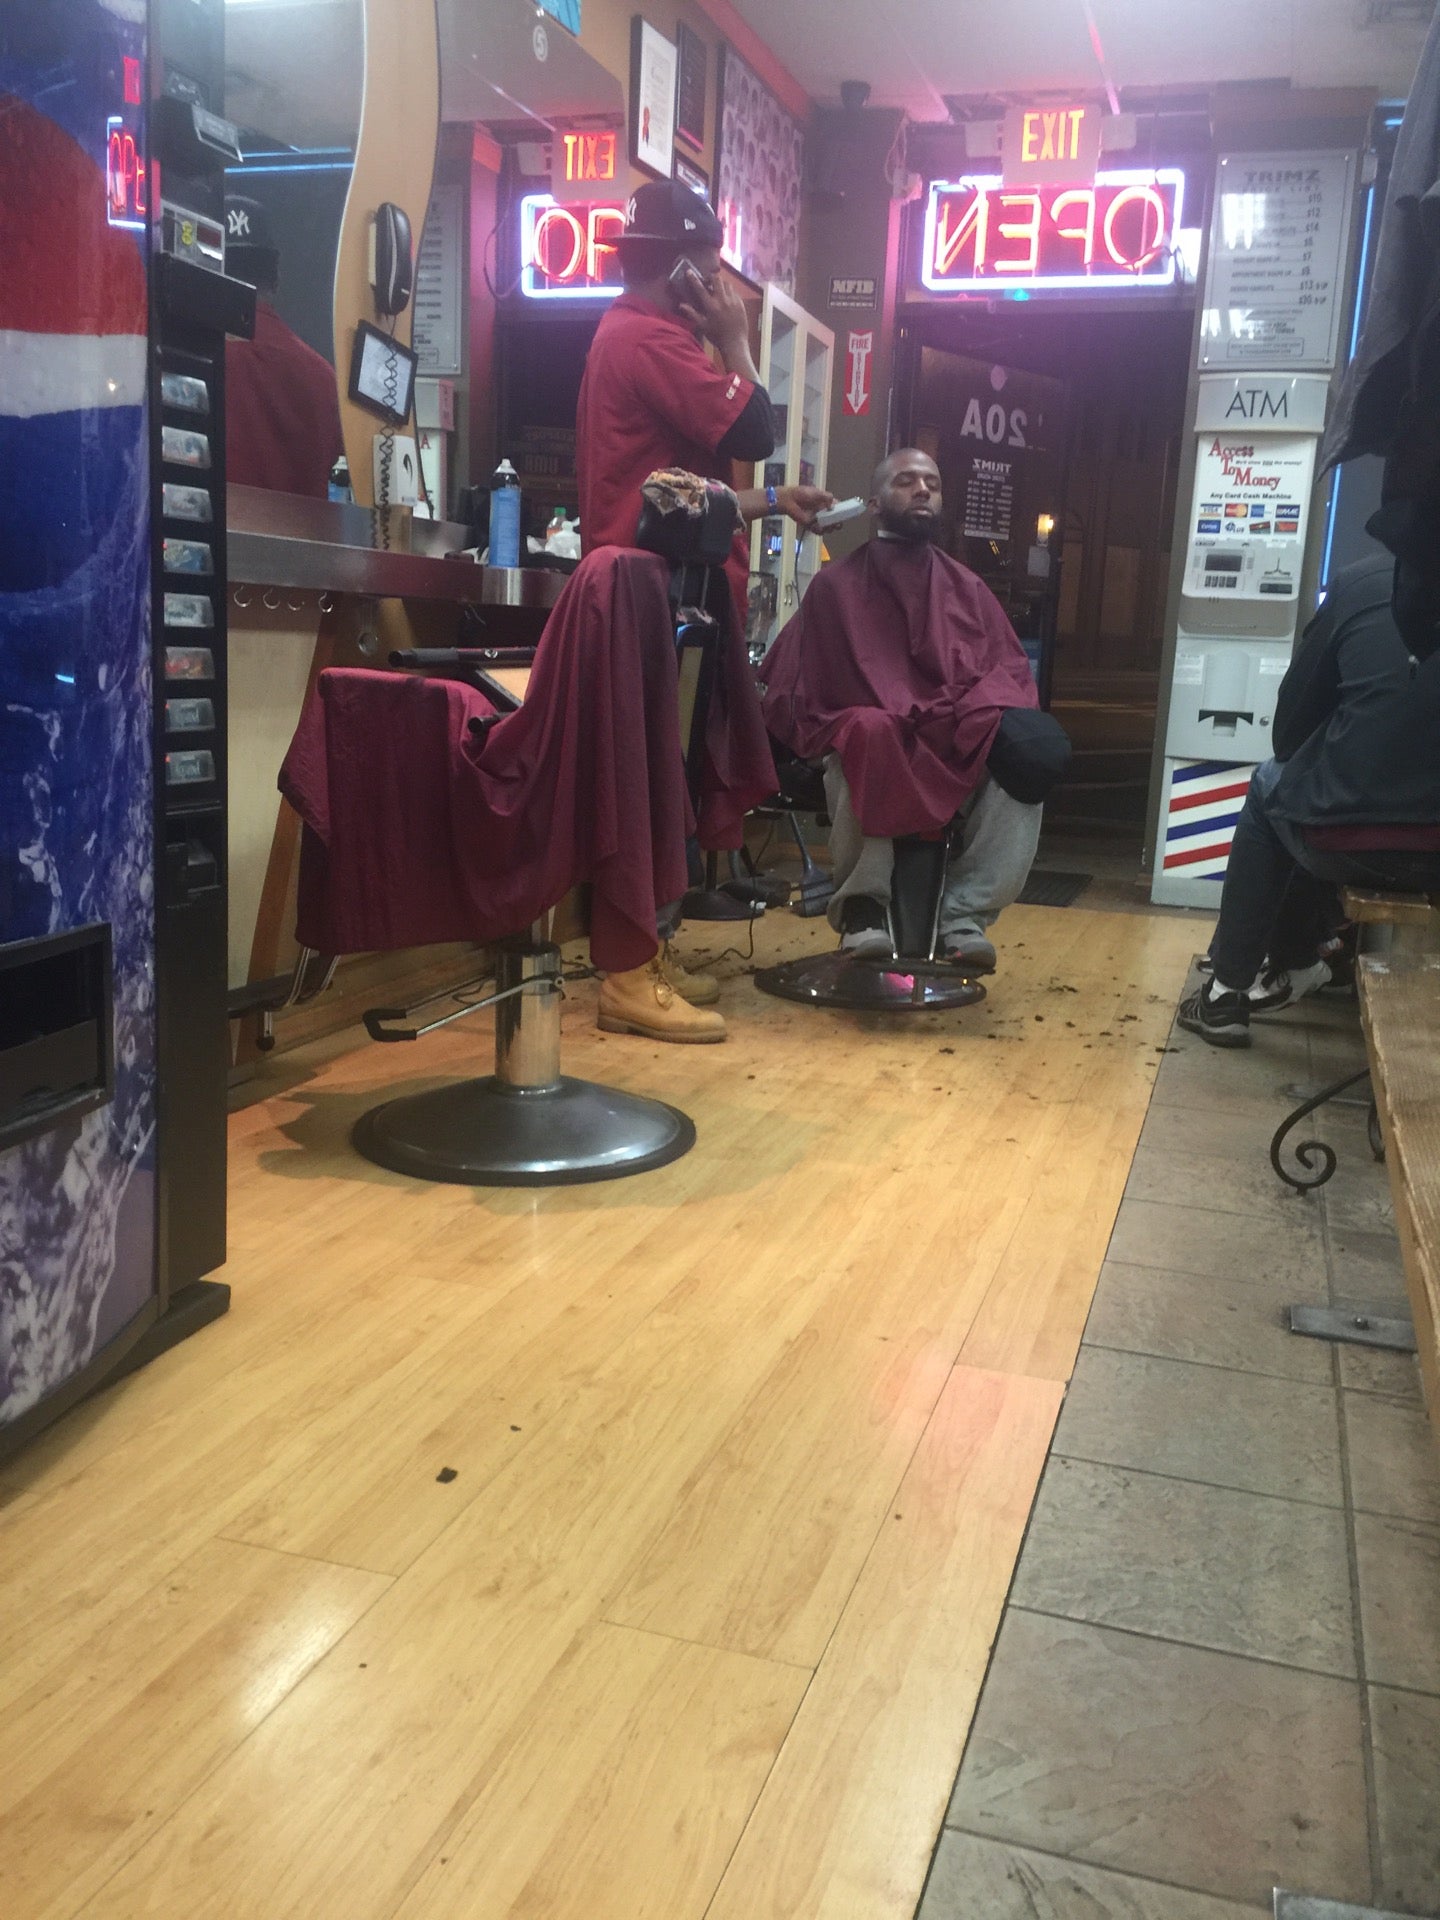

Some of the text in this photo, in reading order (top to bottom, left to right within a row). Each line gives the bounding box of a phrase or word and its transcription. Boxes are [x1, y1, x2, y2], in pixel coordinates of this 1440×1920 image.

[1021, 109, 1085, 163] EXIT
[1244, 169, 1321, 183] TRIMZ
[533, 207, 626, 284] OP
[851, 338, 869, 350] FIRE
[1225, 390, 1289, 419] ATM
[1208, 437, 1255, 458] Access
[1220, 456, 1236, 476] To
[1232, 467, 1281, 491] Money
[1210, 491, 1223, 499] Any
[1224, 491, 1241, 499] Card
